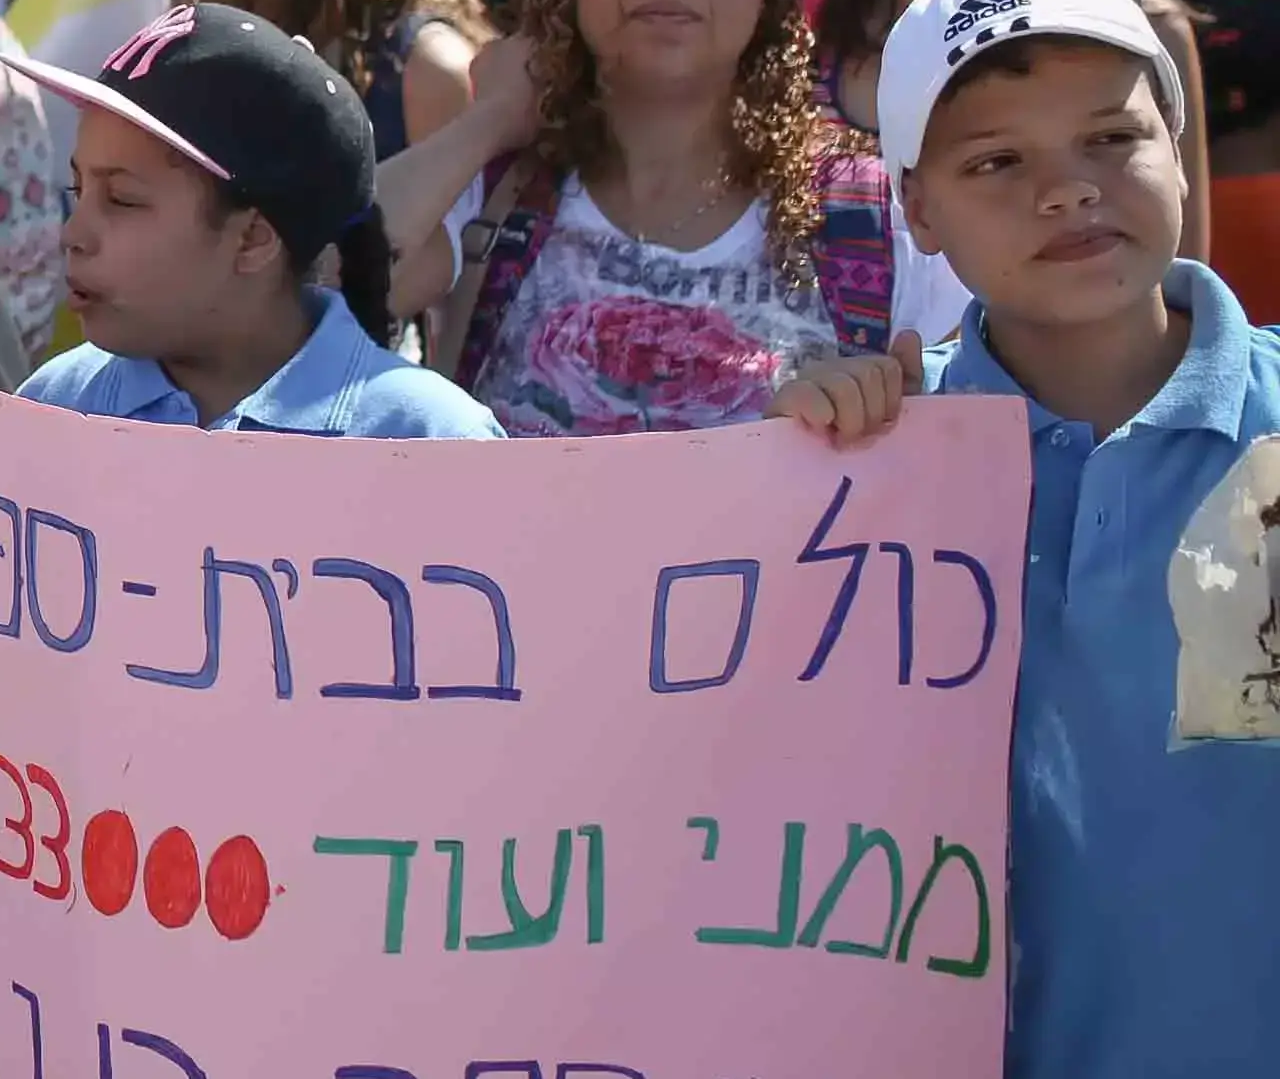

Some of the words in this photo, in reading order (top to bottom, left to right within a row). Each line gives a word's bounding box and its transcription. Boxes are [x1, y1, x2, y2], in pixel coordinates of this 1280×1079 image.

[648, 475, 999, 694] כולם
[312, 823, 606, 955] ועוד
[686, 816, 992, 980] ממני
